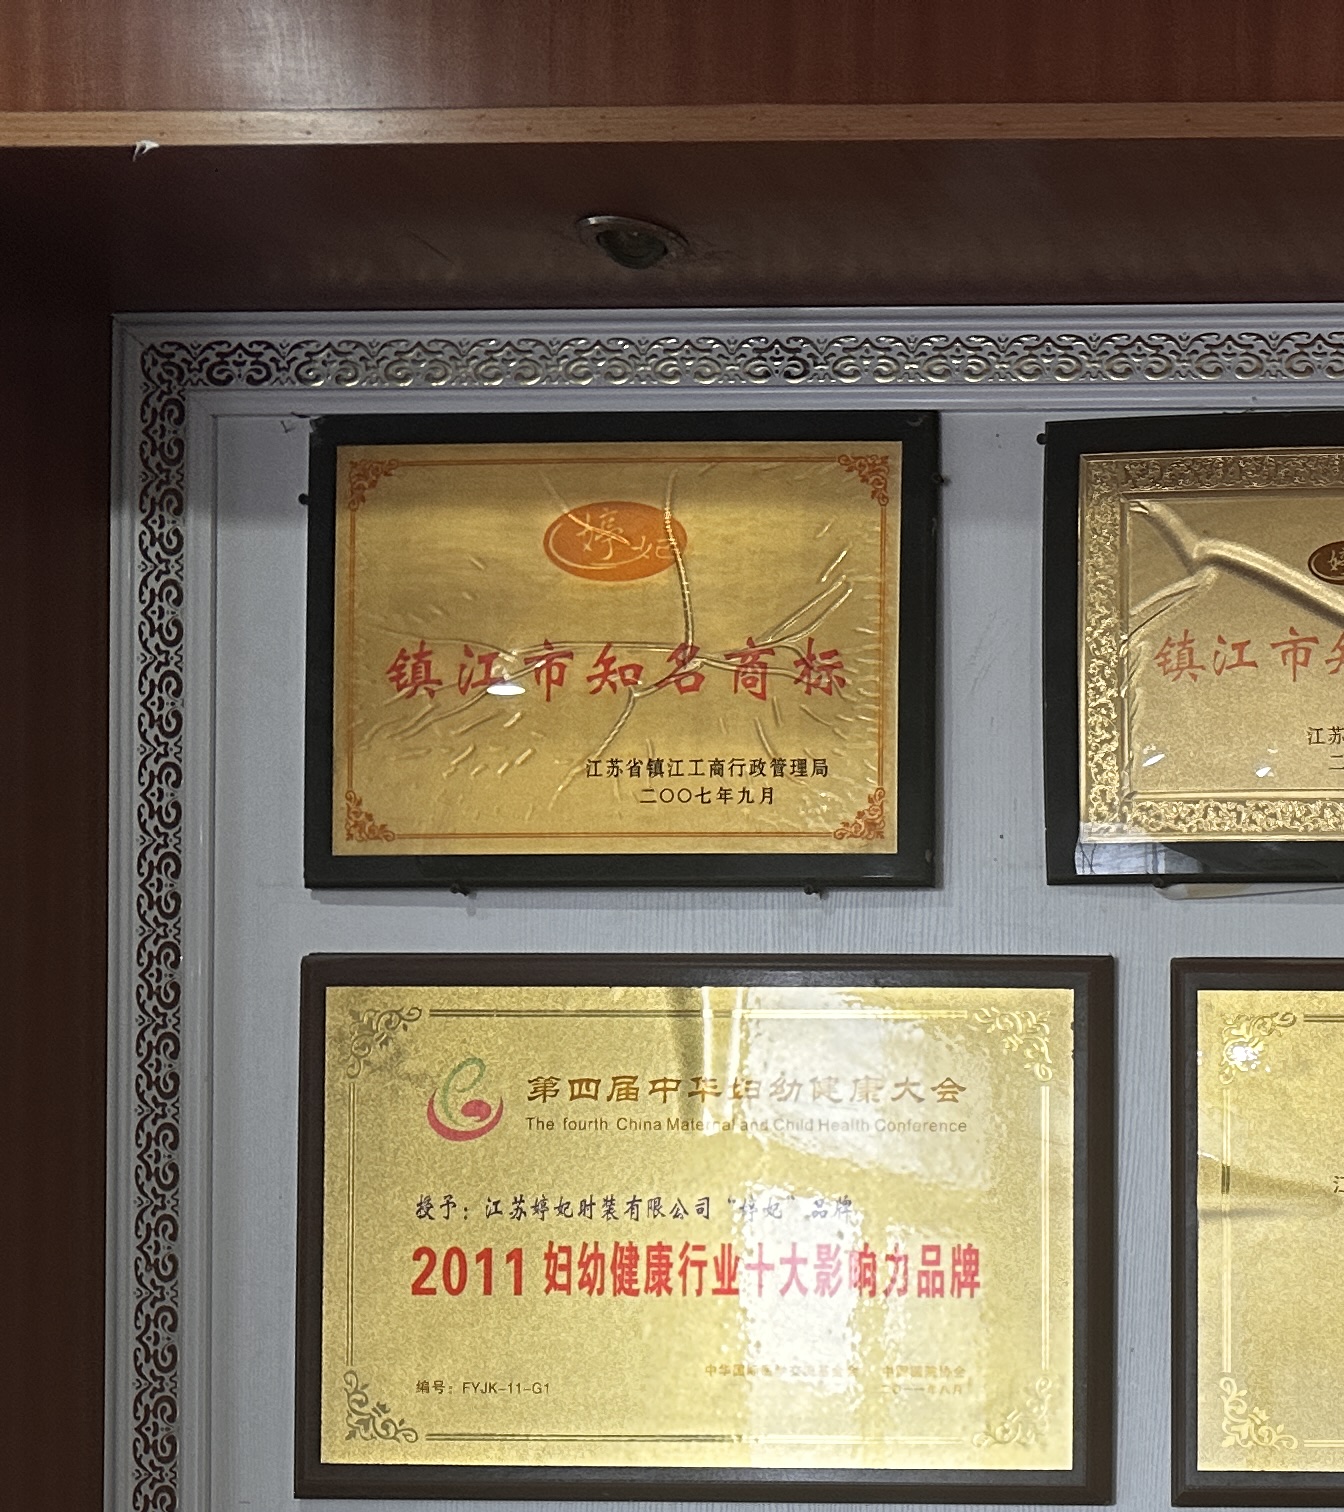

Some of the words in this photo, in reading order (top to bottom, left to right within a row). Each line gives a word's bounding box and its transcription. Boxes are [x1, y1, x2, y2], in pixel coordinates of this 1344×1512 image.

[385, 638, 847, 703] 镇江市知名商标
[586, 759, 829, 779] 江苏省镇江工商行政管理局
[527, 1075, 967, 1104] 第四届中华妇幼健康大会
[526, 1117, 555, 1131] The
[562, 1117, 608, 1131] fourth
[616, 1117, 662, 1131] China
[739, 1118, 770, 1132] and
[773, 1117, 814, 1132] Child
[818, 1118, 870, 1133] Health
